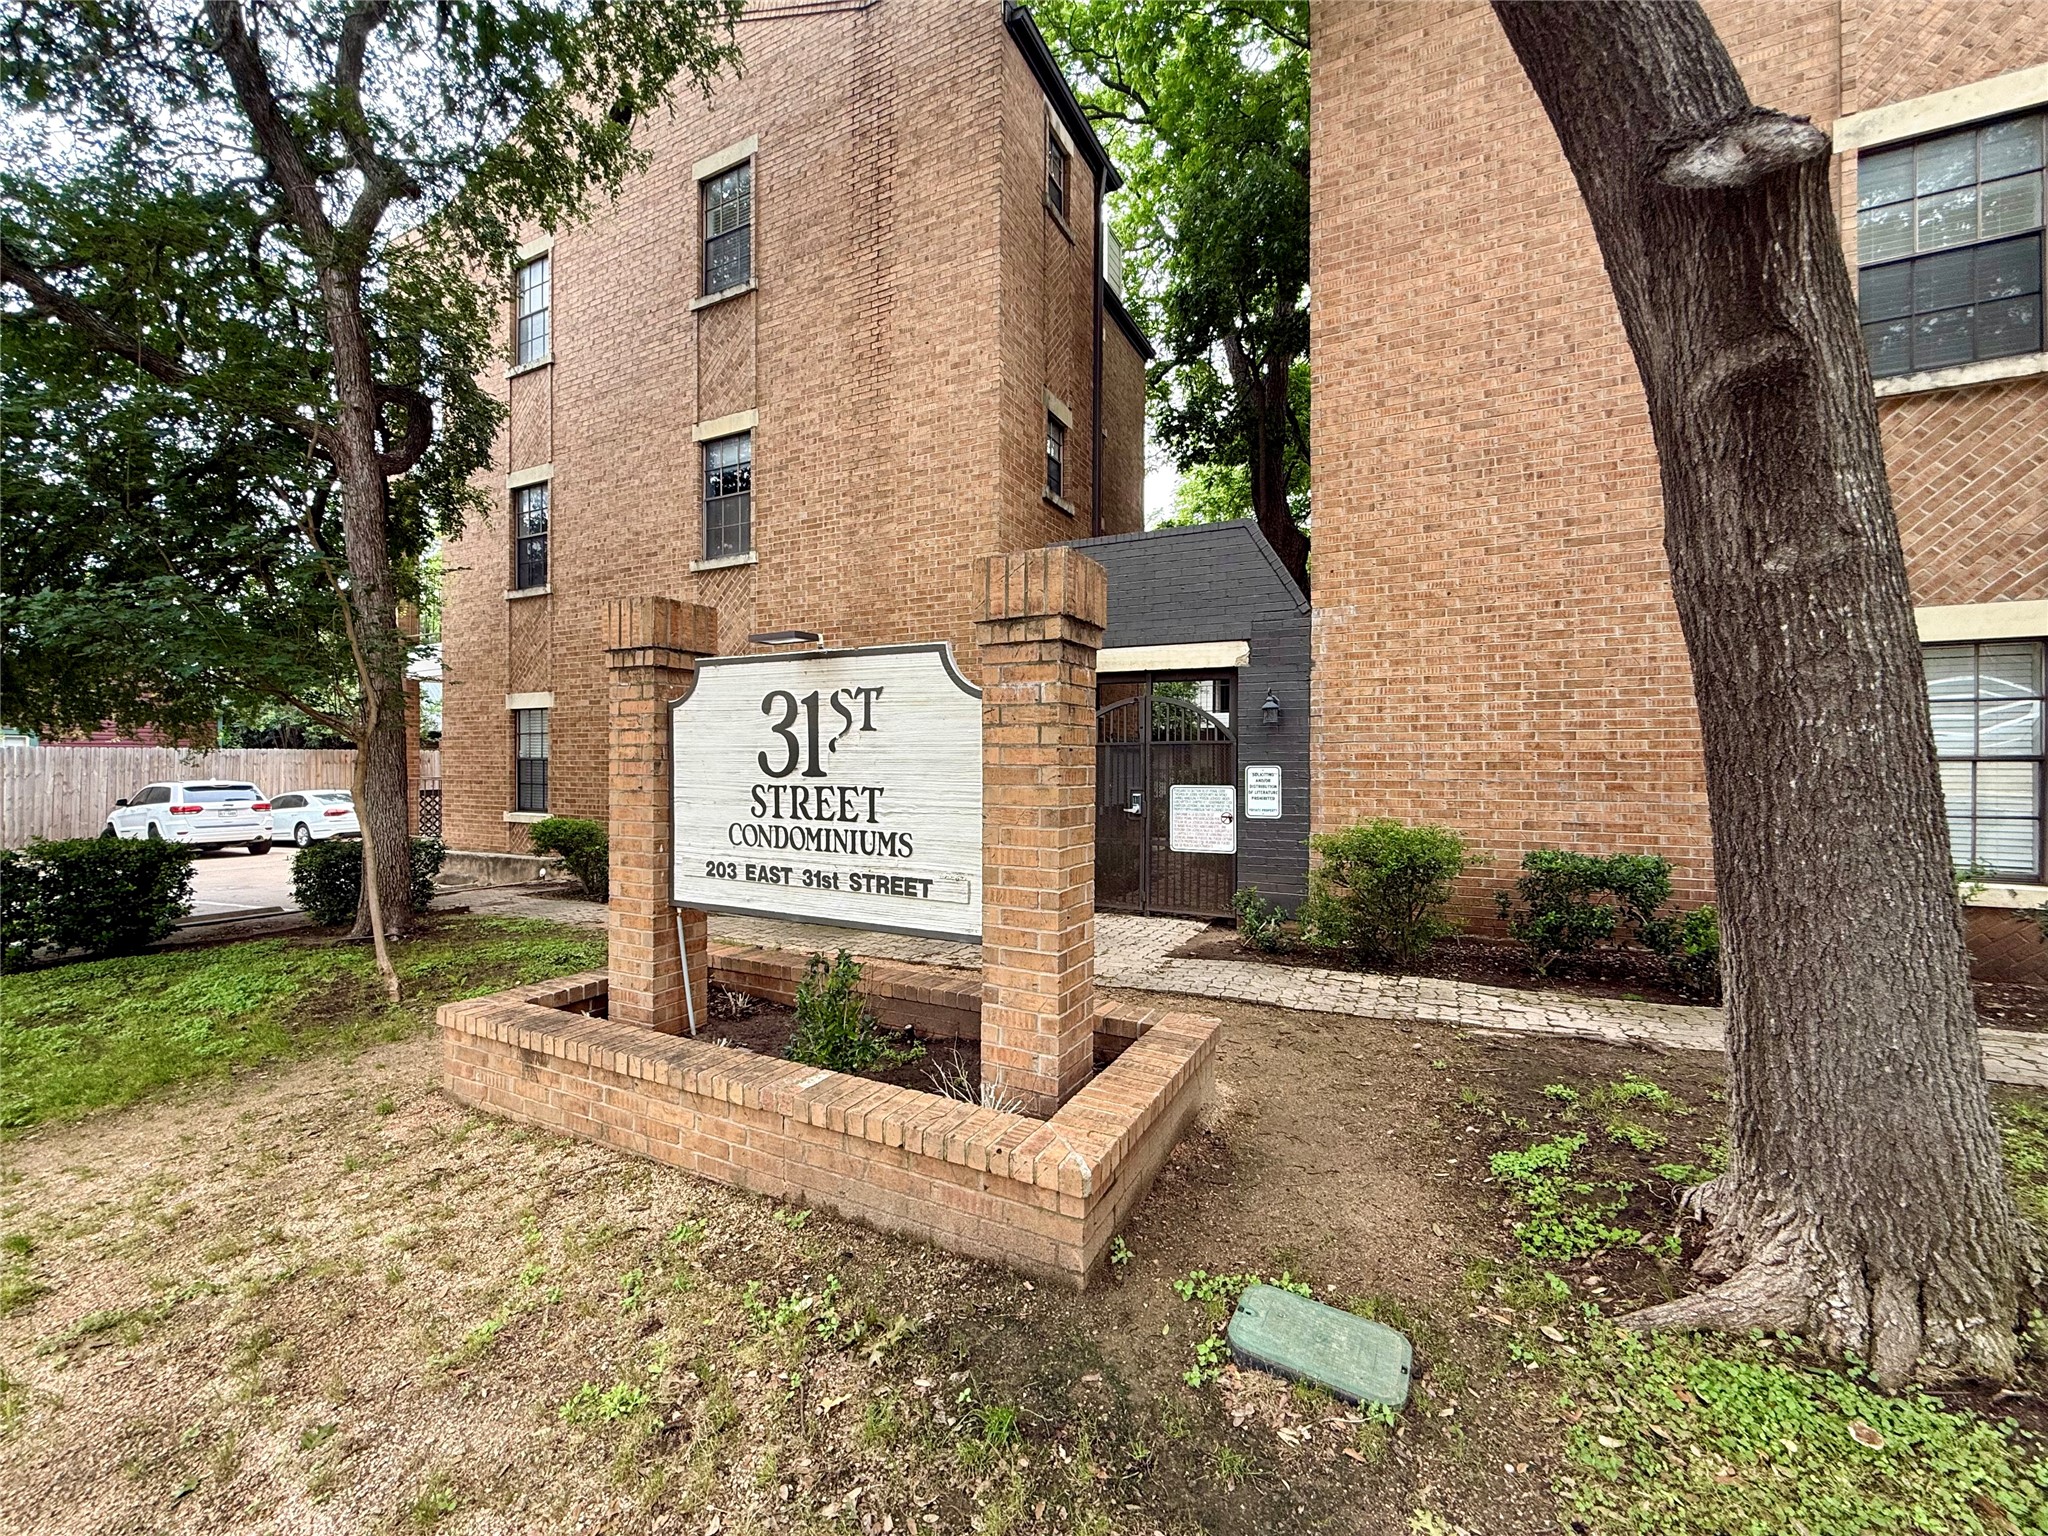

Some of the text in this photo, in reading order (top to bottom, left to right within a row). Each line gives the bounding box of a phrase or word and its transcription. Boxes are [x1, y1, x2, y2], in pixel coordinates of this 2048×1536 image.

[758, 686, 884, 778] 31ST
[751, 784, 884, 823] STREET
[728, 822, 914, 859] CONDOMINIUMS
[705, 860, 934, 898] 203 EAST 31st STREET
